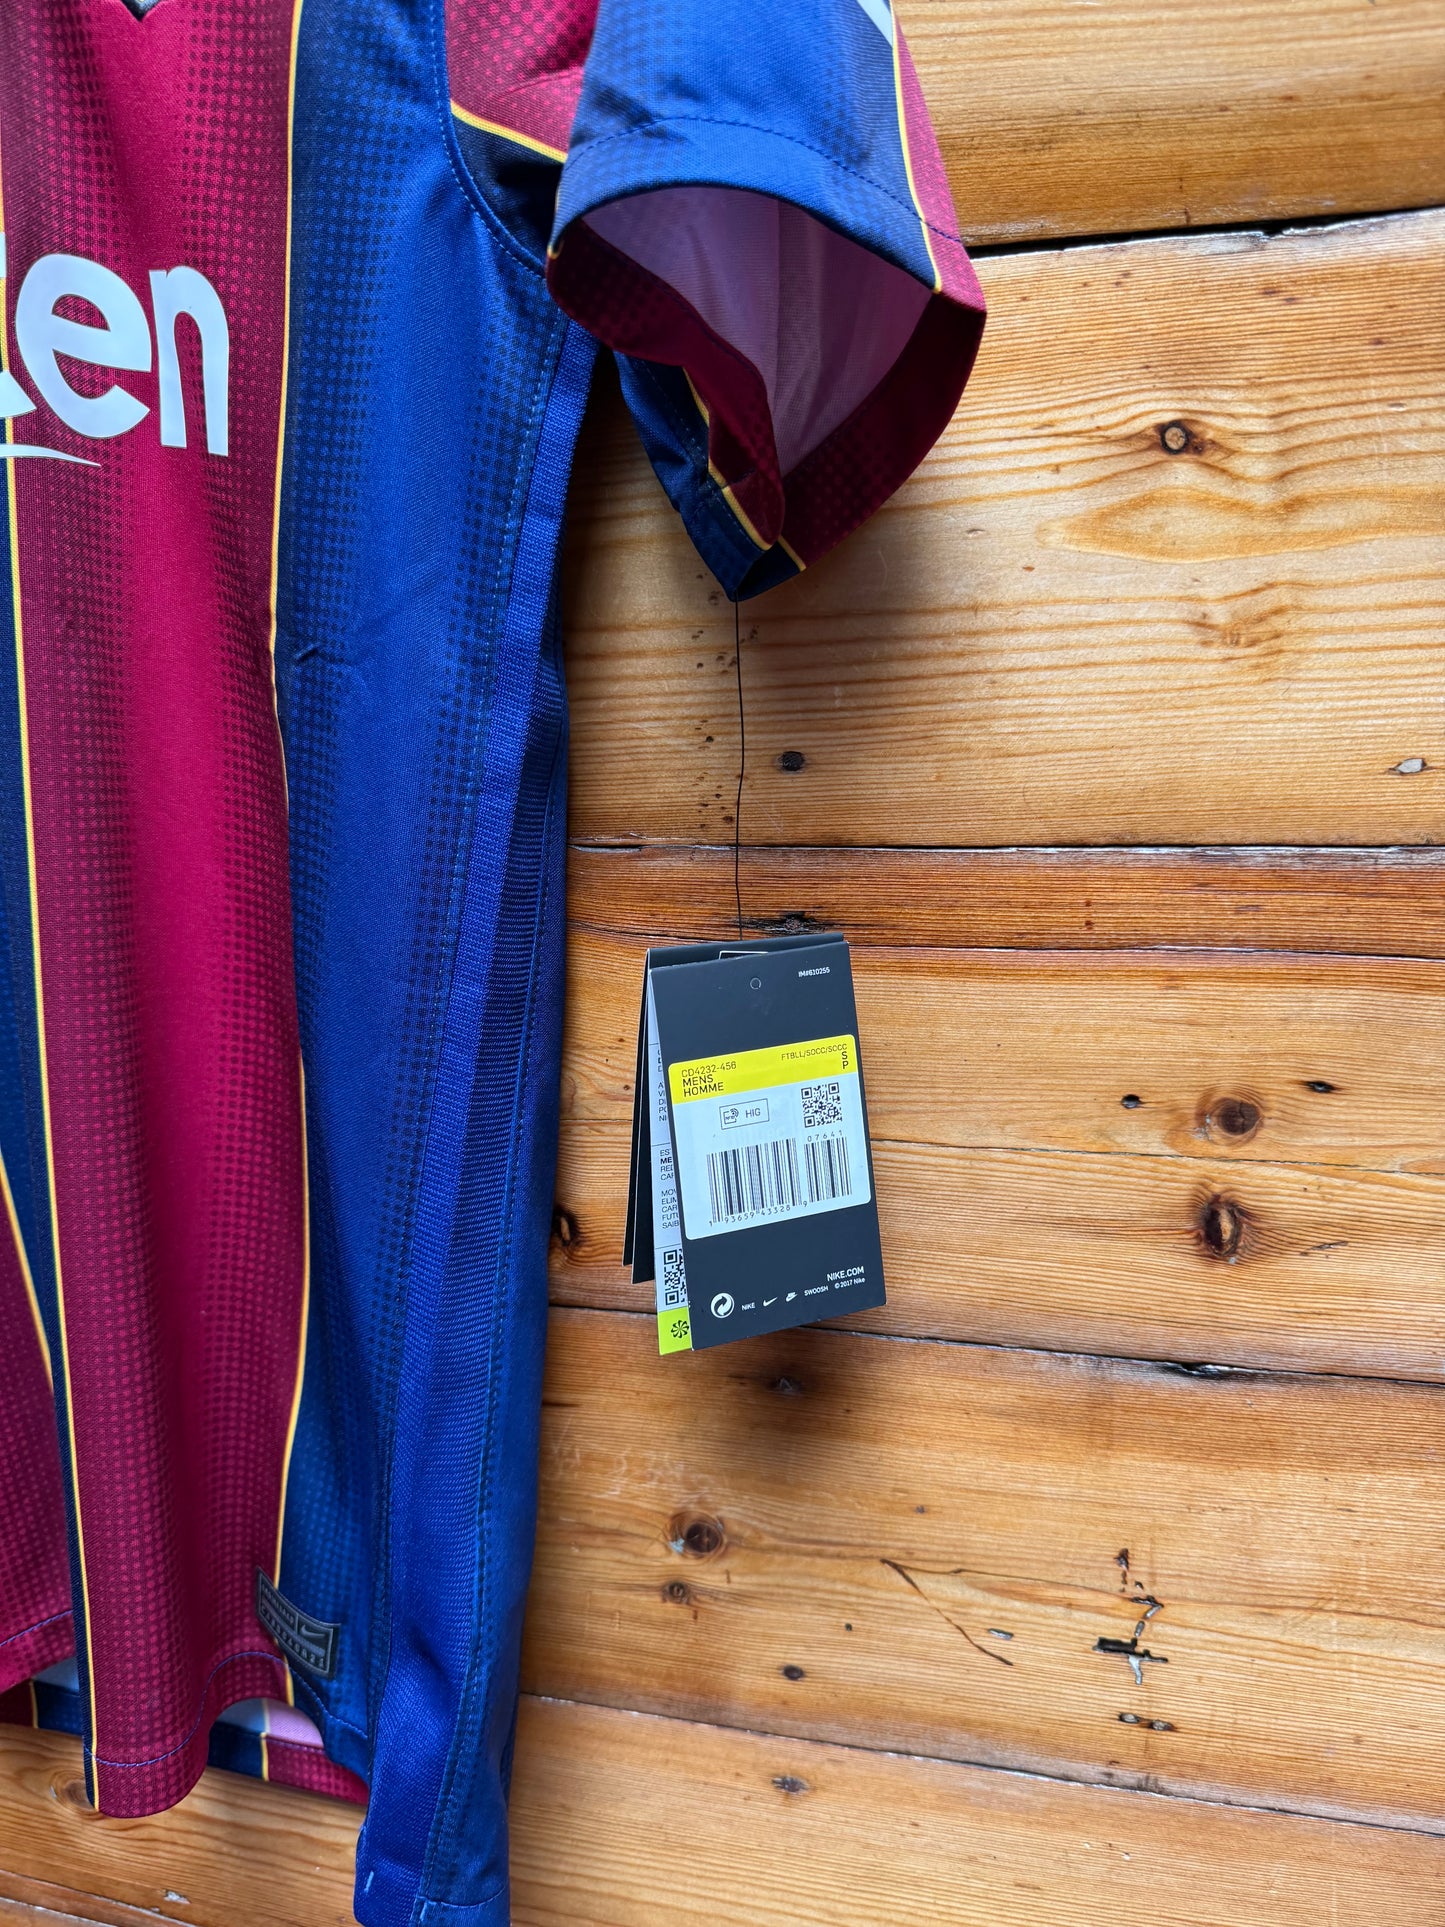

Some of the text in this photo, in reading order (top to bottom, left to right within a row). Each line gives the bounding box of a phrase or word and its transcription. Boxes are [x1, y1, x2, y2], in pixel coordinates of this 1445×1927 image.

[0, 231, 229, 457] en
[841, 1051, 848, 1060] S
[681, 1061, 737, 1078] CD4232-456
[842, 1060, 849, 1069] P
[682, 1074, 714, 1088] MENS
[683, 1082, 725, 1098] HOMME
[745, 1107, 761, 1119] HIG
[826, 1265, 865, 1282] NIKE.COM
[804, 1285, 829, 1297] SWOOSH
[741, 1301, 756, 1312] NIKE
